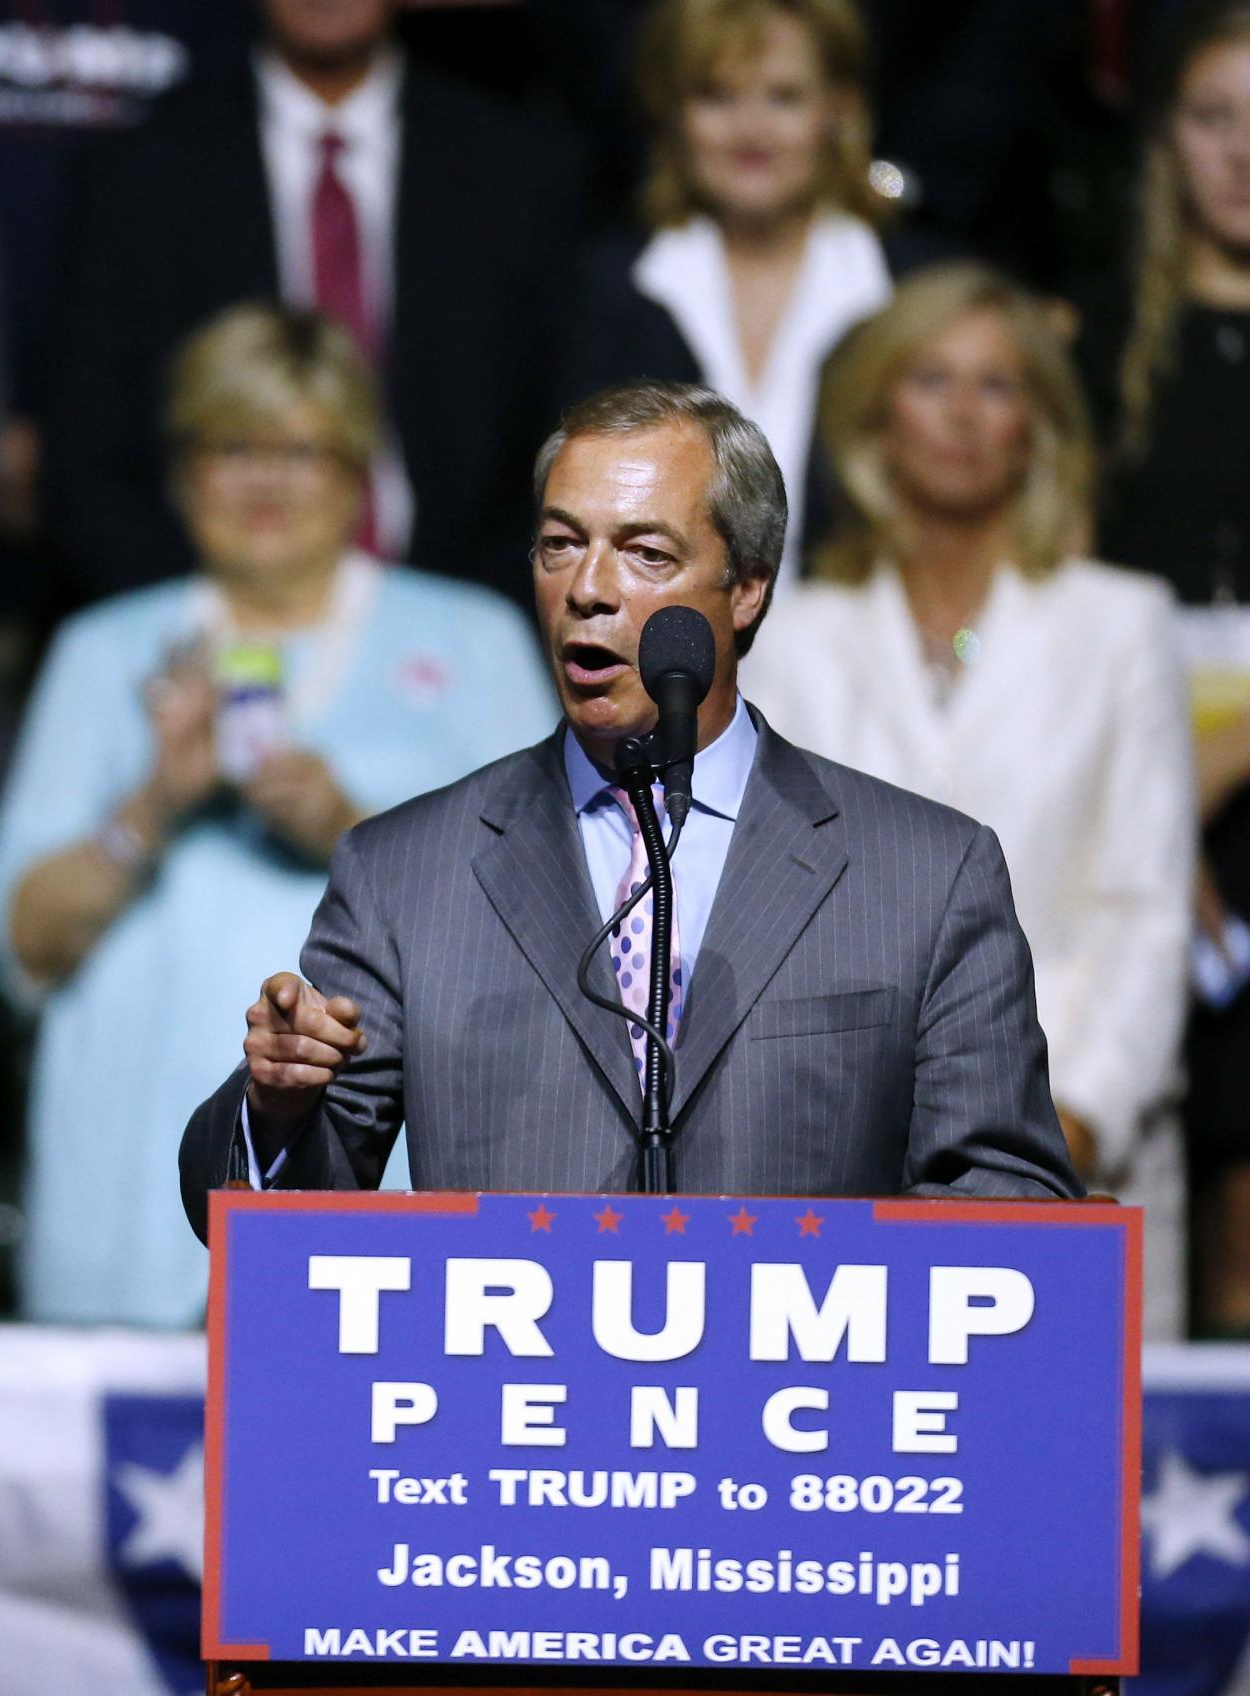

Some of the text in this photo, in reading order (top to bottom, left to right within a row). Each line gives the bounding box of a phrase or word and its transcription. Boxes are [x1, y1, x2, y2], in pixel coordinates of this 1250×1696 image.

[308, 1255, 1035, 1365] TRUMP
[370, 1381, 959, 1454] PENCE
[368, 1469, 964, 1514] Text TRUMP to 88022
[376, 1543, 960, 1607] Jackson, Mississippi
[304, 1628, 1035, 1669] MAKE AMERICA GREAT AGAIN!
